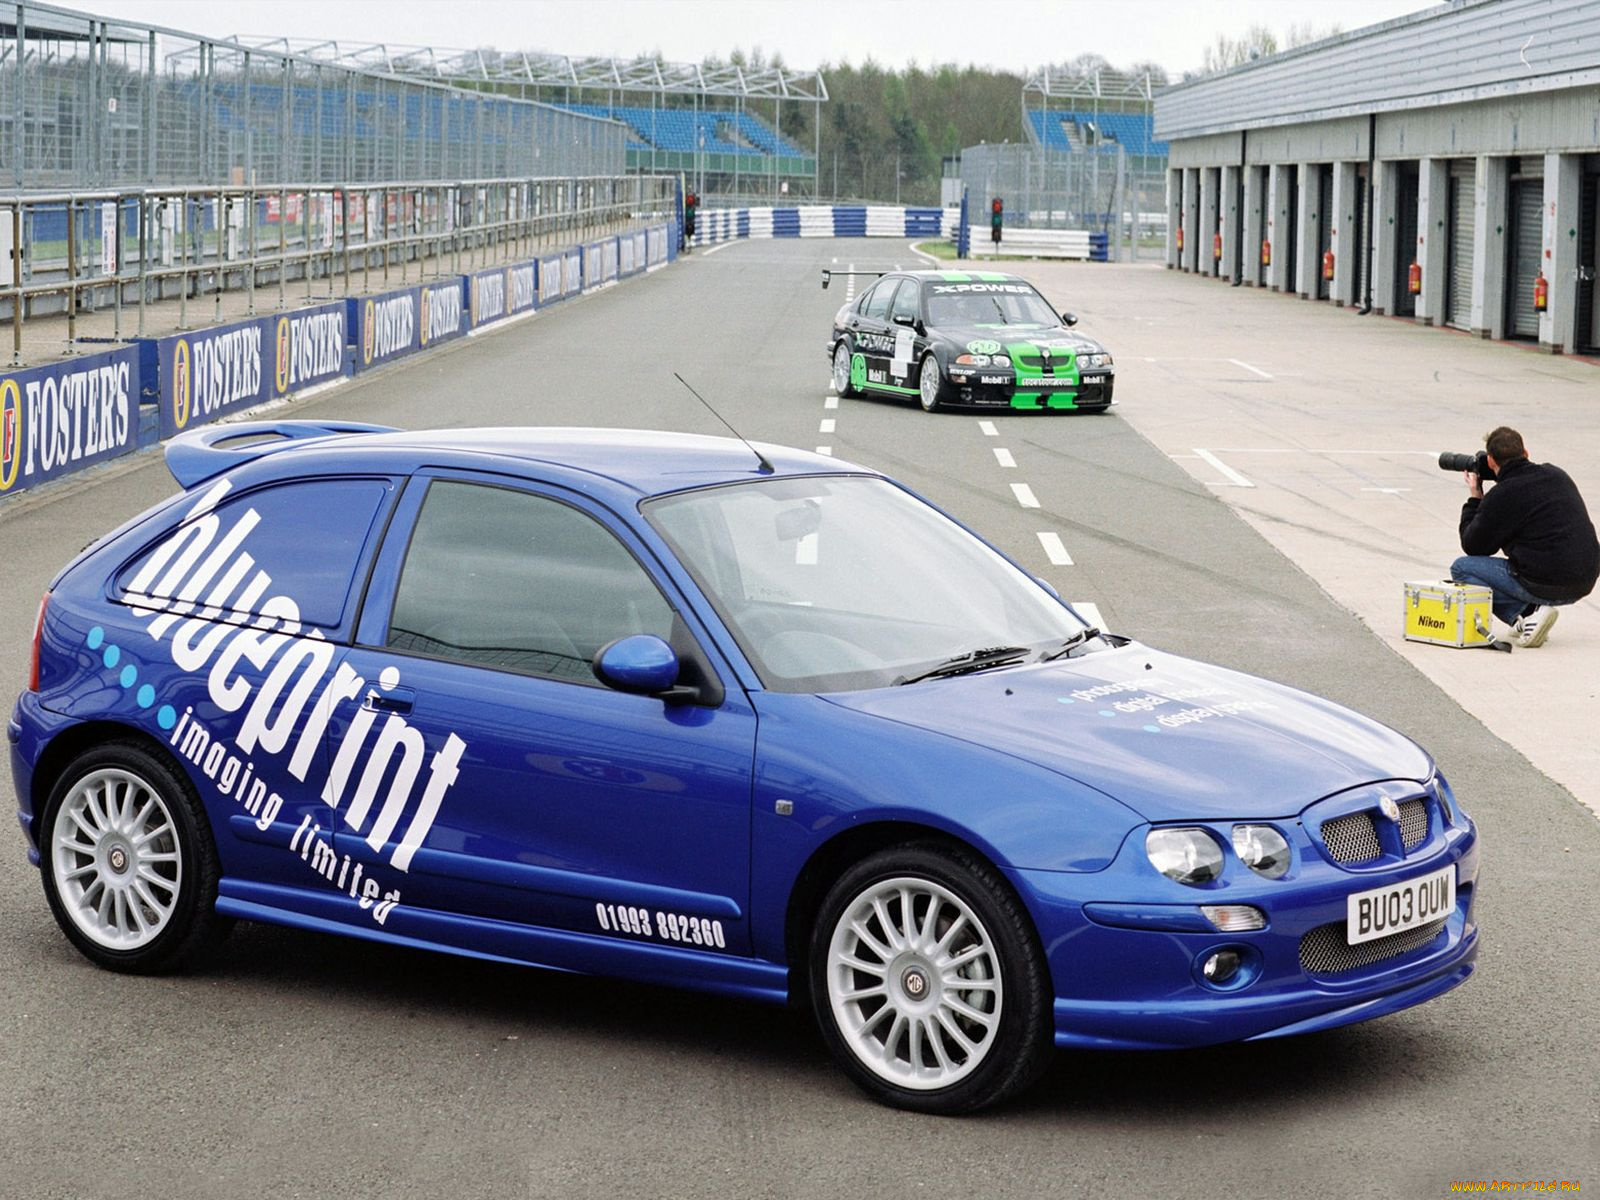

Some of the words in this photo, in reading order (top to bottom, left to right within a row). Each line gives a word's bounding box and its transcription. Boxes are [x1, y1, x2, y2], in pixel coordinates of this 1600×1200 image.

[933, 284, 1033, 295] XPOWER
[191, 326, 262, 417] FOSTER'S
[25, 361, 130, 476] FOSTER'S
[1417, 615, 1446, 629] Nikon
[121, 478, 467, 874] blueprint
[169, 706, 284, 831] imaging
[289, 813, 402, 925] limited
[1358, 887, 1414, 936] BU03
[596, 902, 653, 937] 01993
[655, 911, 726, 949] 892360
